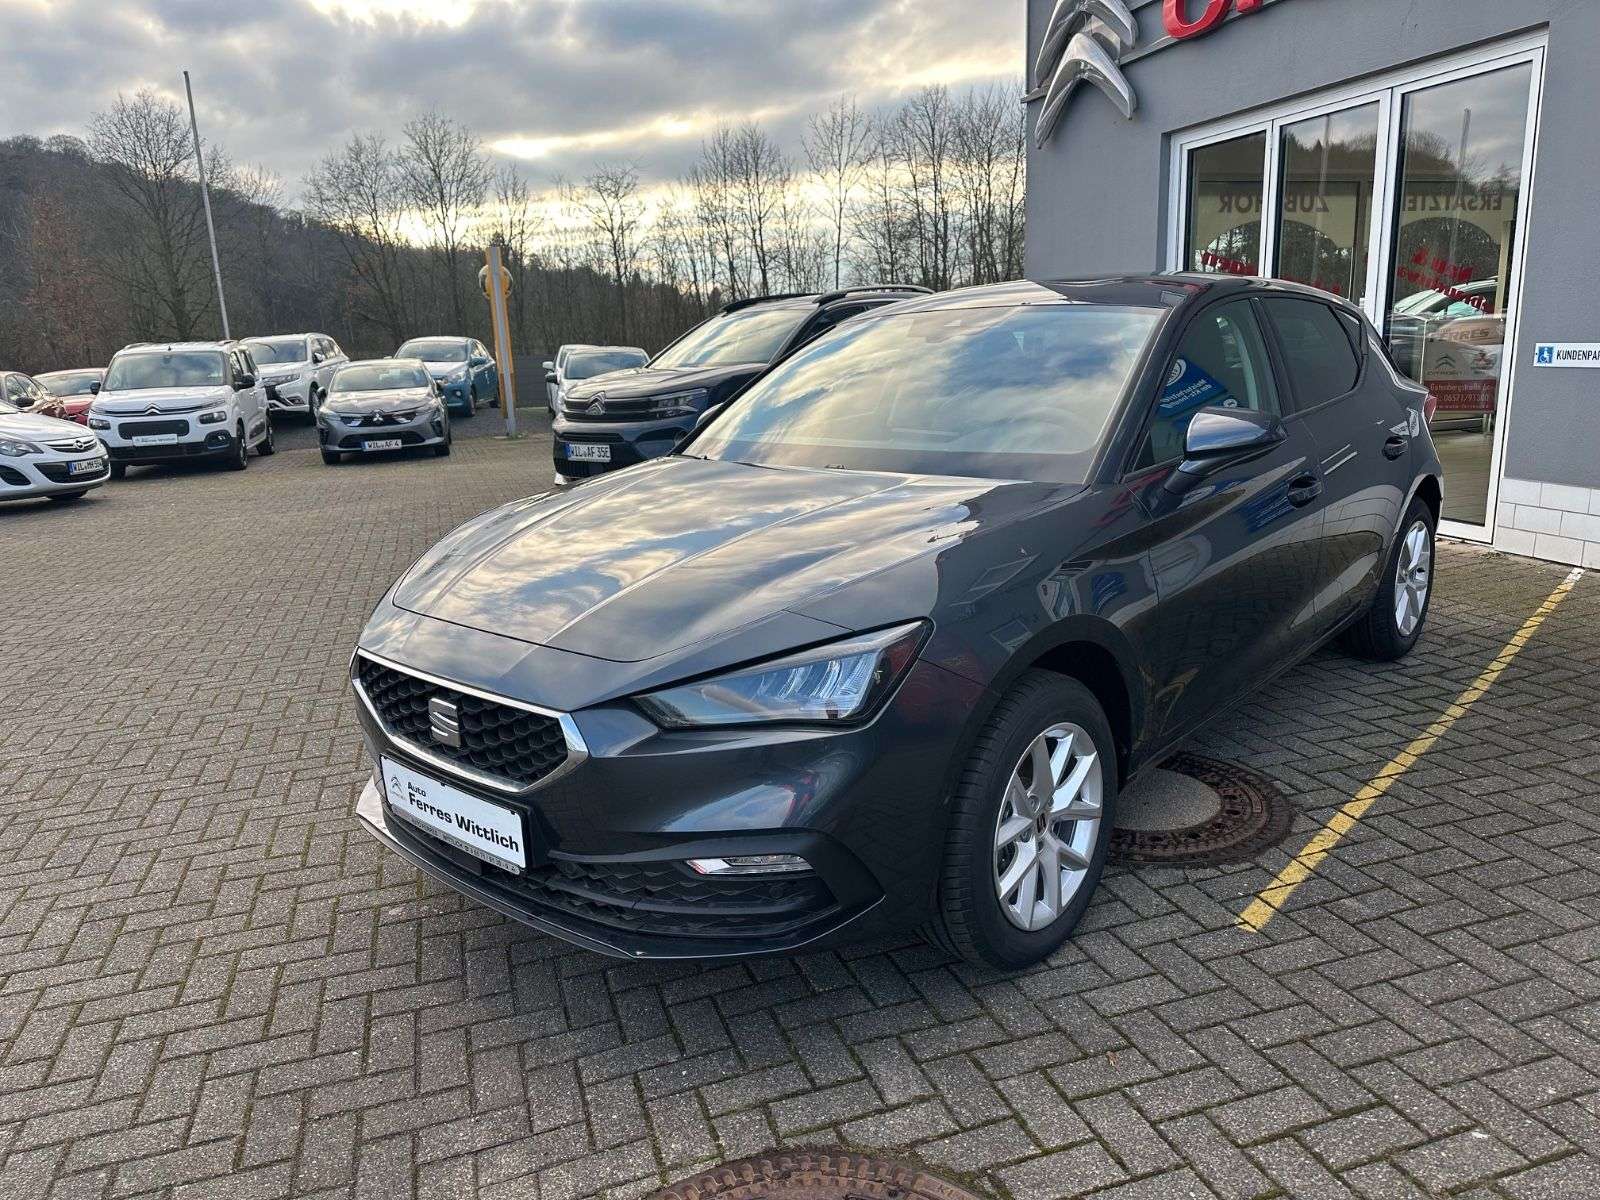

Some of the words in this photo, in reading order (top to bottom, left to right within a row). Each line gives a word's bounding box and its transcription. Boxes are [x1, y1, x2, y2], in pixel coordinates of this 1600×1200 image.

[407, 781, 427, 797] Auto
[408, 791, 452, 824] Ferres
[455, 813, 519, 852] Wittlich
